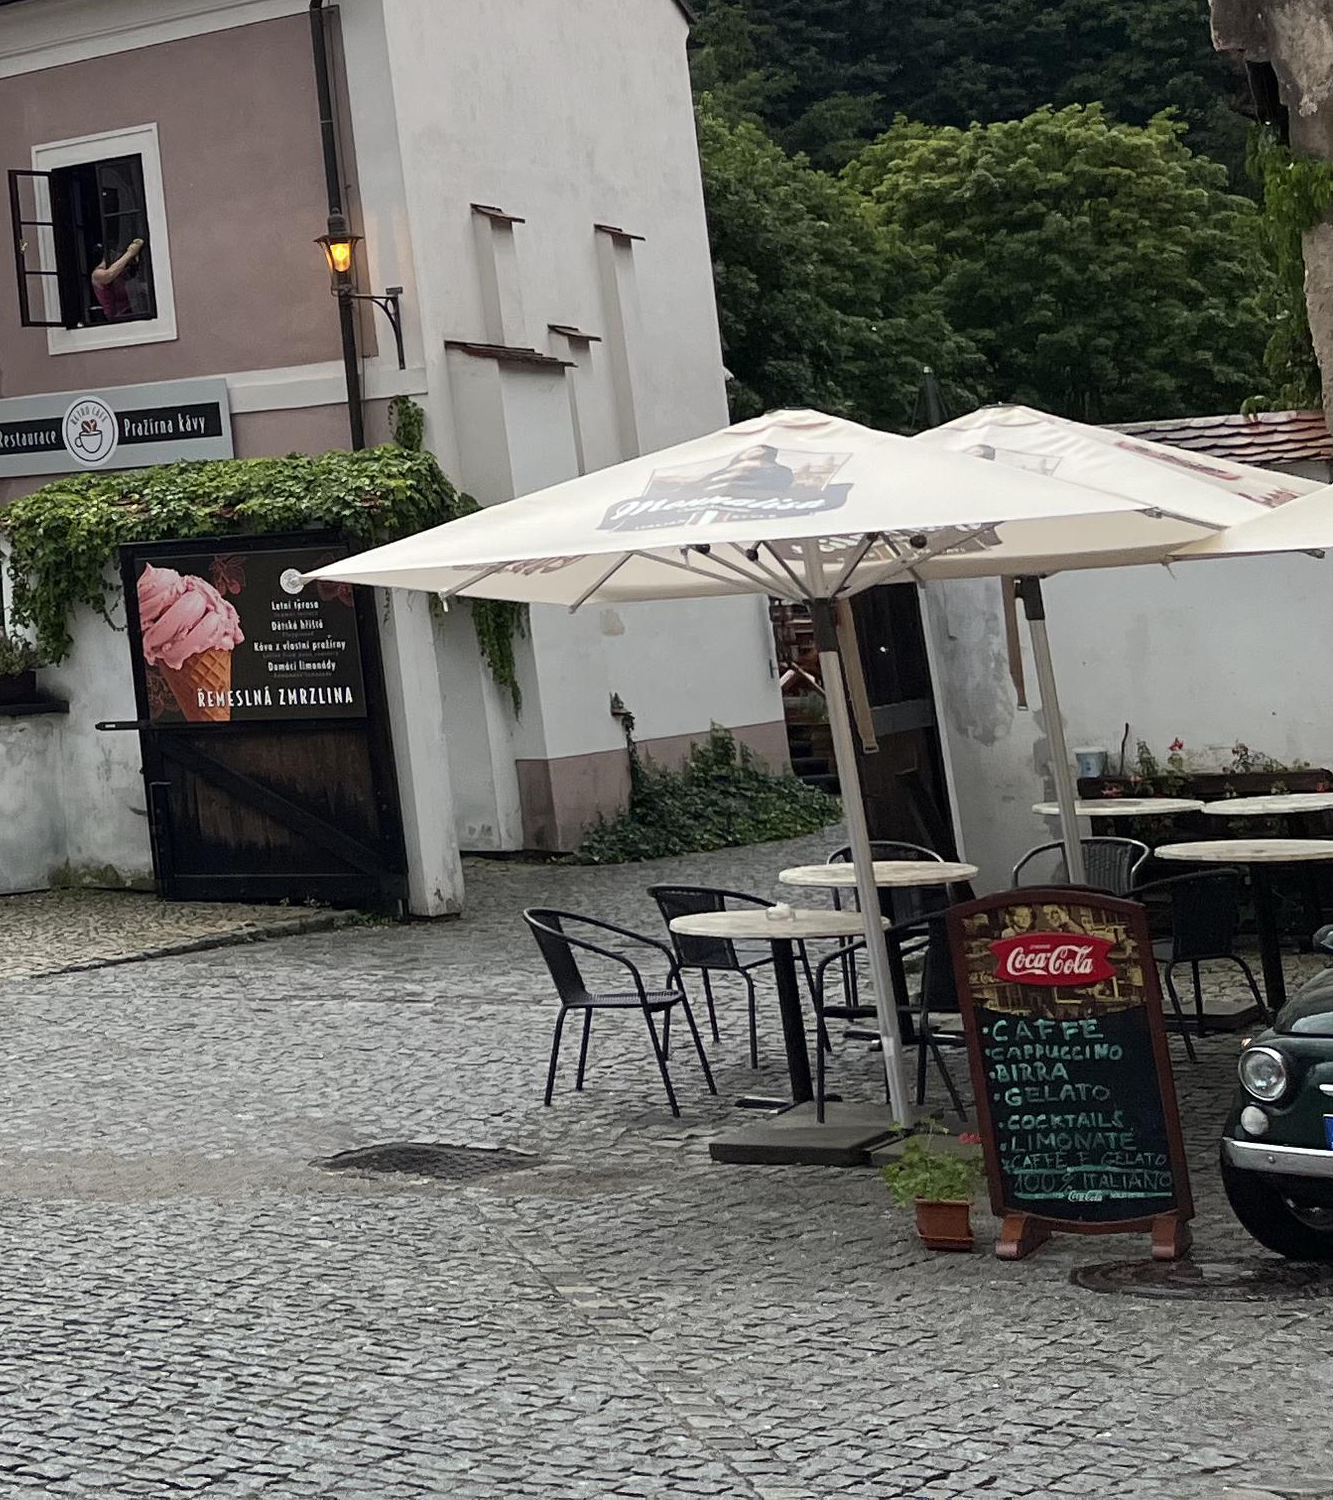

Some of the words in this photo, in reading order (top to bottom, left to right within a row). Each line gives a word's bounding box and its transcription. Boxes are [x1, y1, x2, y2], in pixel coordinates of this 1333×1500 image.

[197, 686, 273, 708] ŘEMESLNÁ
[278, 686, 354, 706] ZMRZLINA
[1006, 945, 1094, 976] Coca-Cola
[991, 1043, 1123, 1061] CAPPUCCINO
[995, 1062, 1069, 1082] BIRRA
[1005, 1083, 1110, 1106] GELATO
[1007, 1110, 1124, 1130] COCKTAILS
[1011, 1131, 1137, 1152] LIMONATE
[1101, 1151, 1167, 1166] GELATO
[1083, 1170, 1173, 1191] ITALIANO
